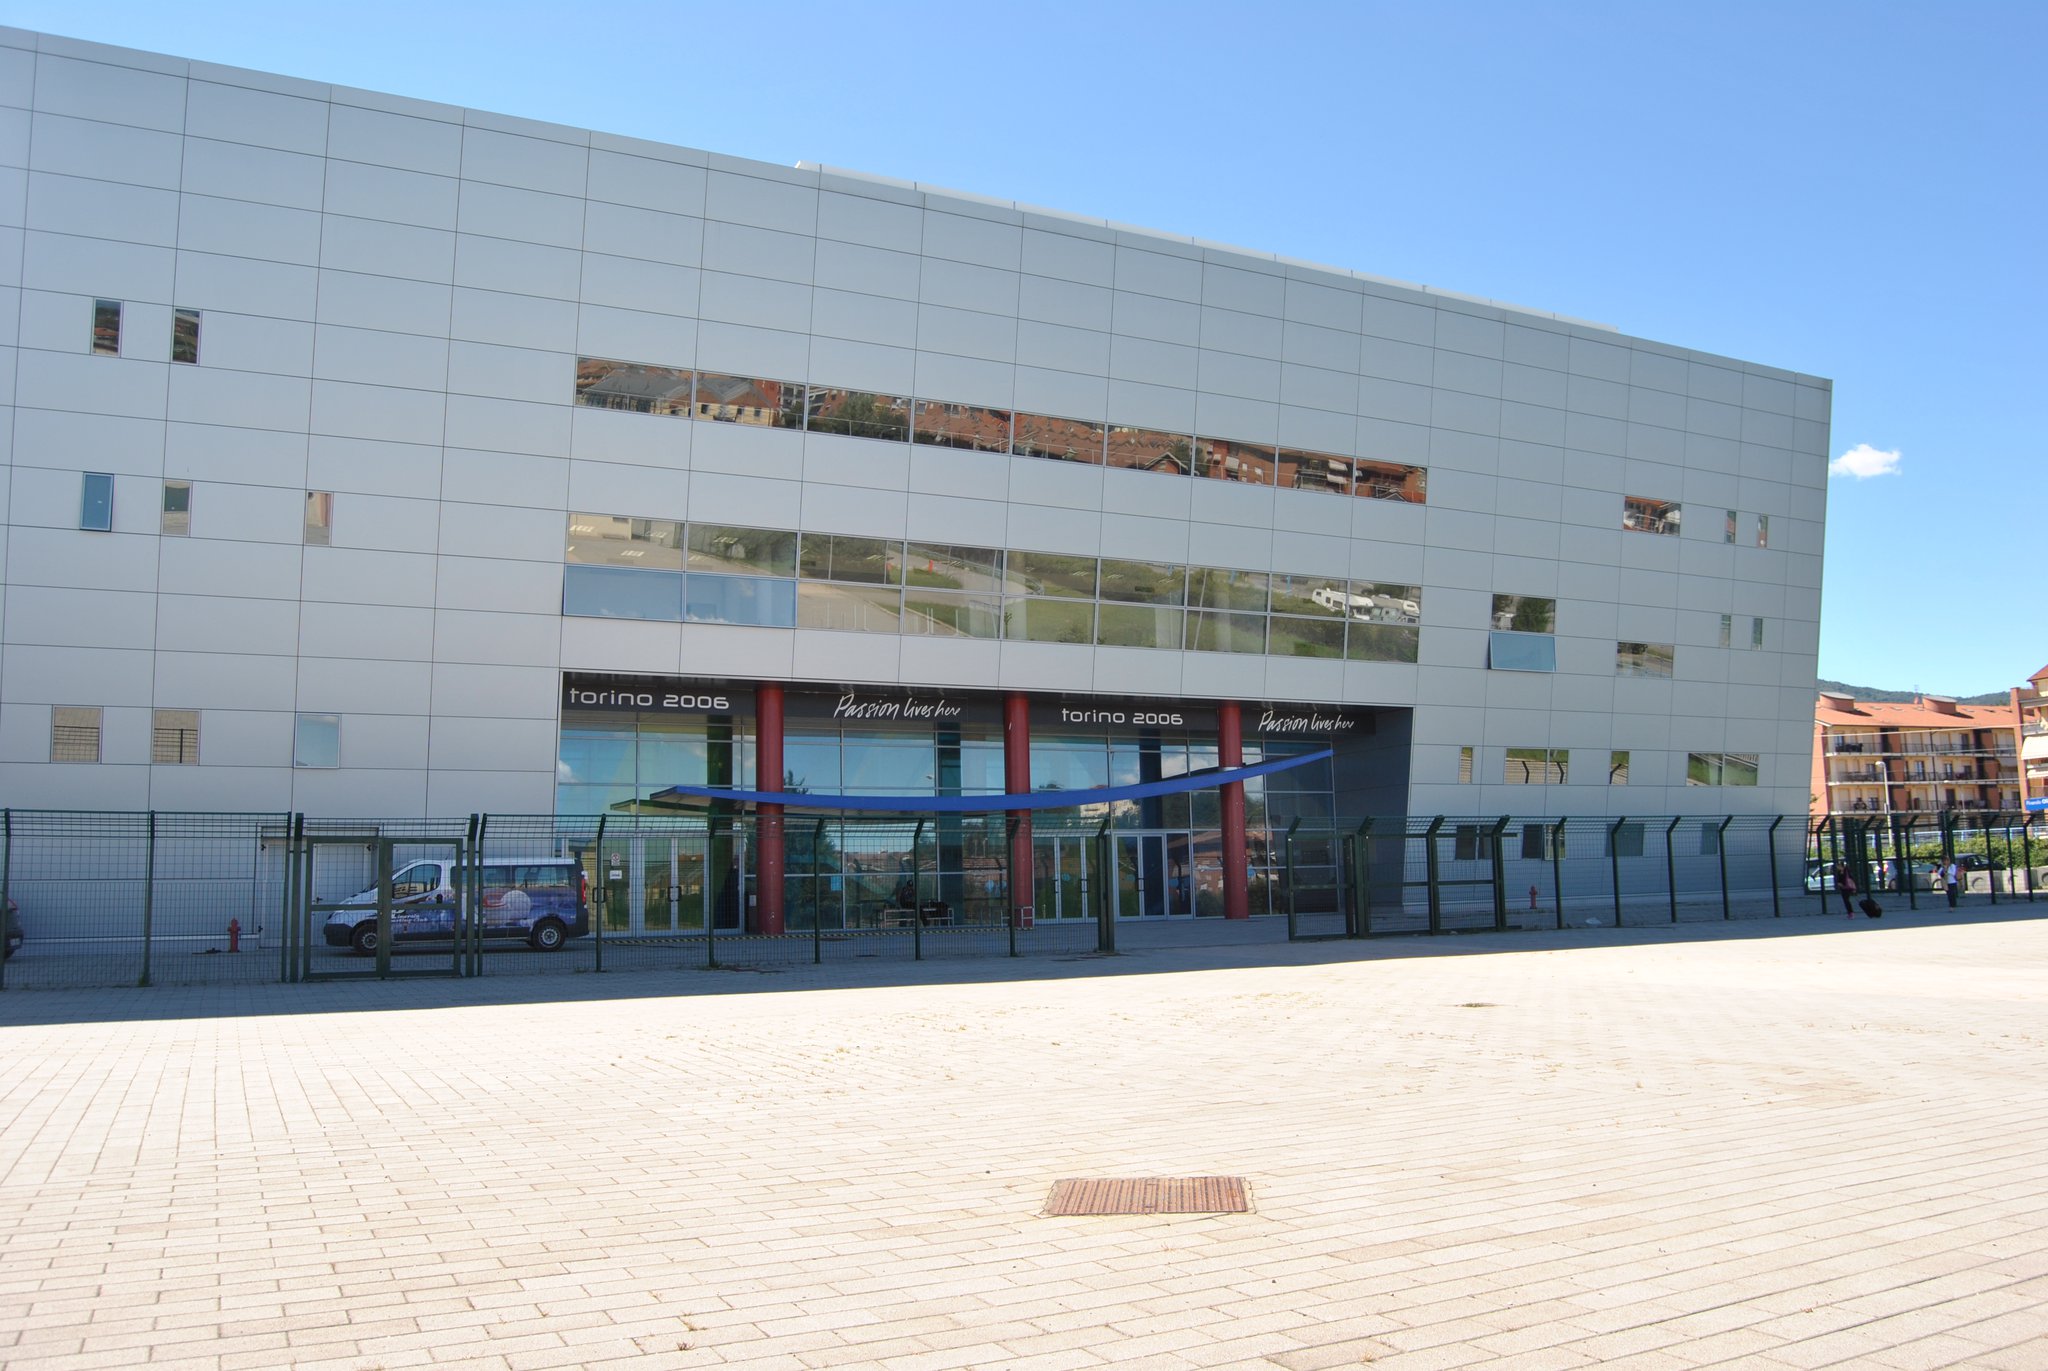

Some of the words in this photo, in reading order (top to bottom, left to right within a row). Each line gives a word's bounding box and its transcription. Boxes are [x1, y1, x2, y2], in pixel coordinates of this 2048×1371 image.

[569, 687, 653, 706] torino
[663, 694, 730, 710] 2006
[833, 693, 900, 720] Passion
[903, 697, 934, 718] lives
[934, 699, 961, 718] here
[1061, 707, 1125, 723] torino
[1132, 712, 1183, 725] 2006
[1258, 710, 1308, 733] Passion
[1311, 713, 1333, 731] lives
